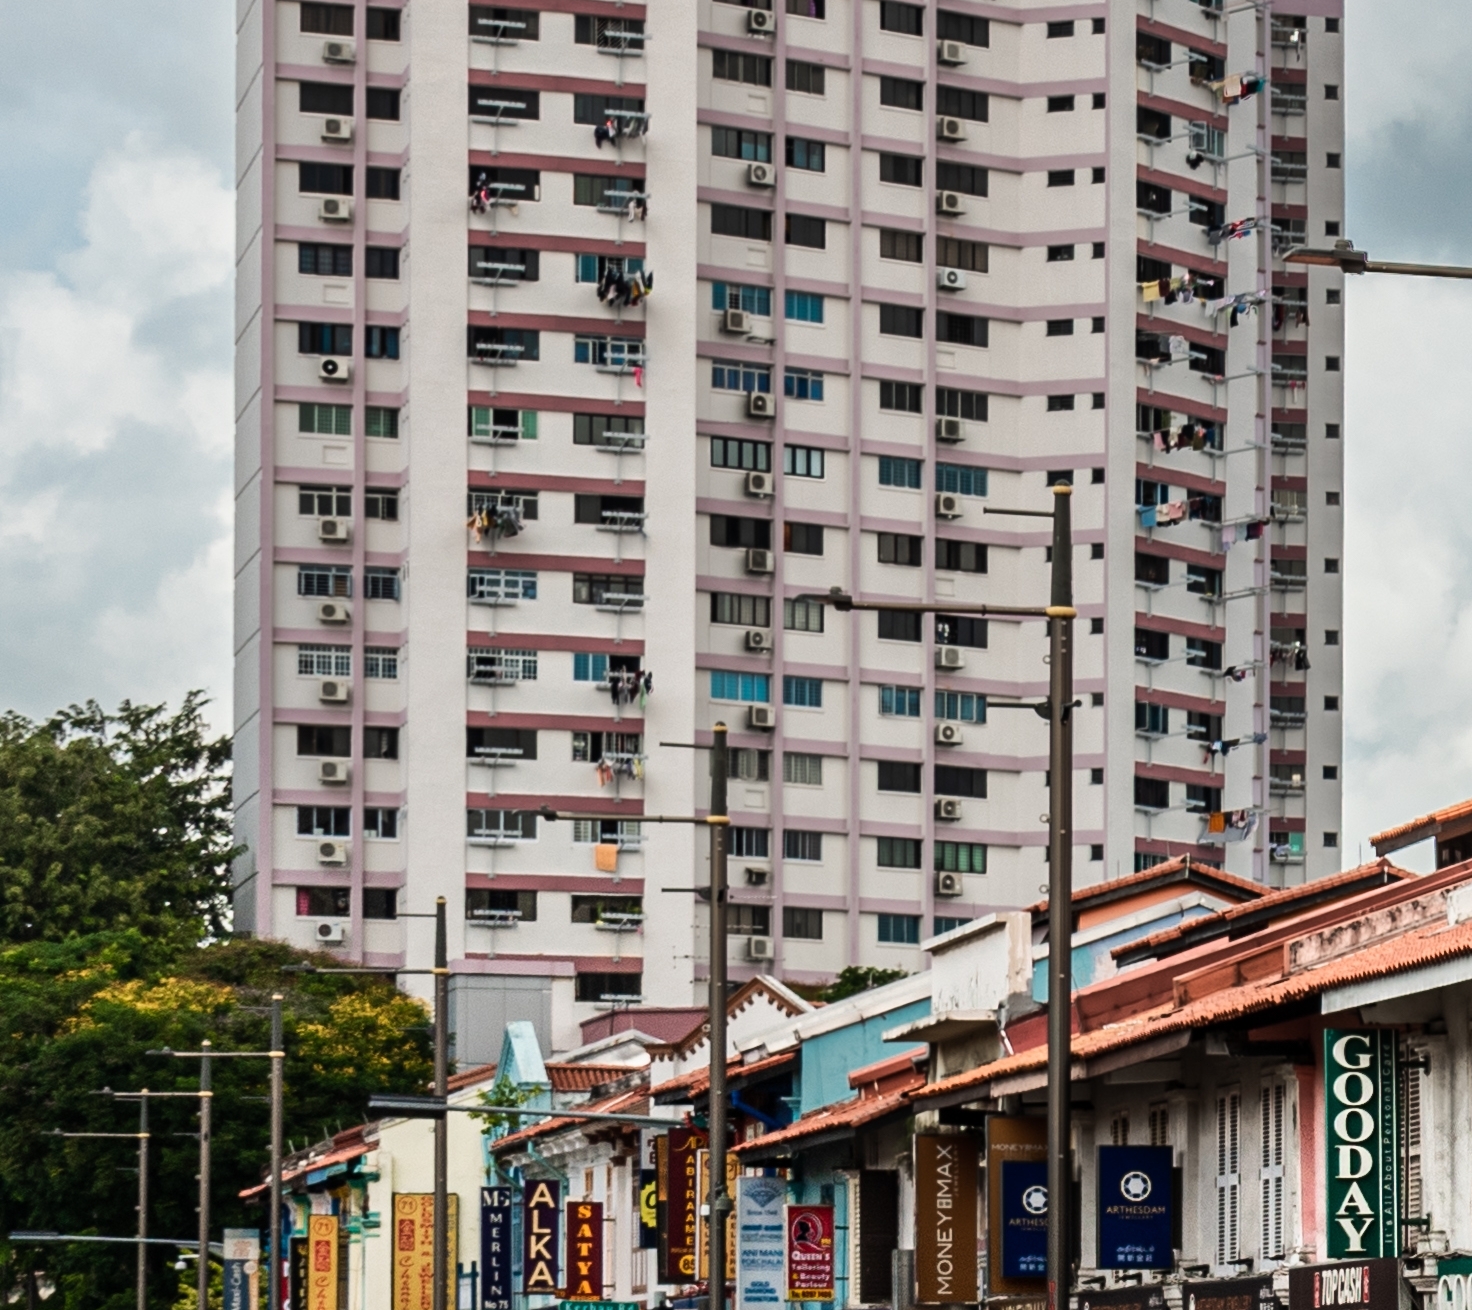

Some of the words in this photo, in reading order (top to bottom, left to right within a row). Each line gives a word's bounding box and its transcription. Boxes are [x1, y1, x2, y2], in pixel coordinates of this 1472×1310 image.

[1383, 1044, 1392, 1076] Care
[1384, 1083, 1393, 1144] Personal
[1332, 1034, 1374, 1252] GOODAY
[1384, 1149, 1393, 1191] About
[1106, 1205, 1166, 1215] ARTHESDAM
[1384, 1196, 1393, 1216] All
[490, 1212, 503, 1296] MERLIN
[529, 1183, 556, 1286] ALKA
[577, 1205, 594, 1294] SATYA
[484, 1299, 497, 1310] No
